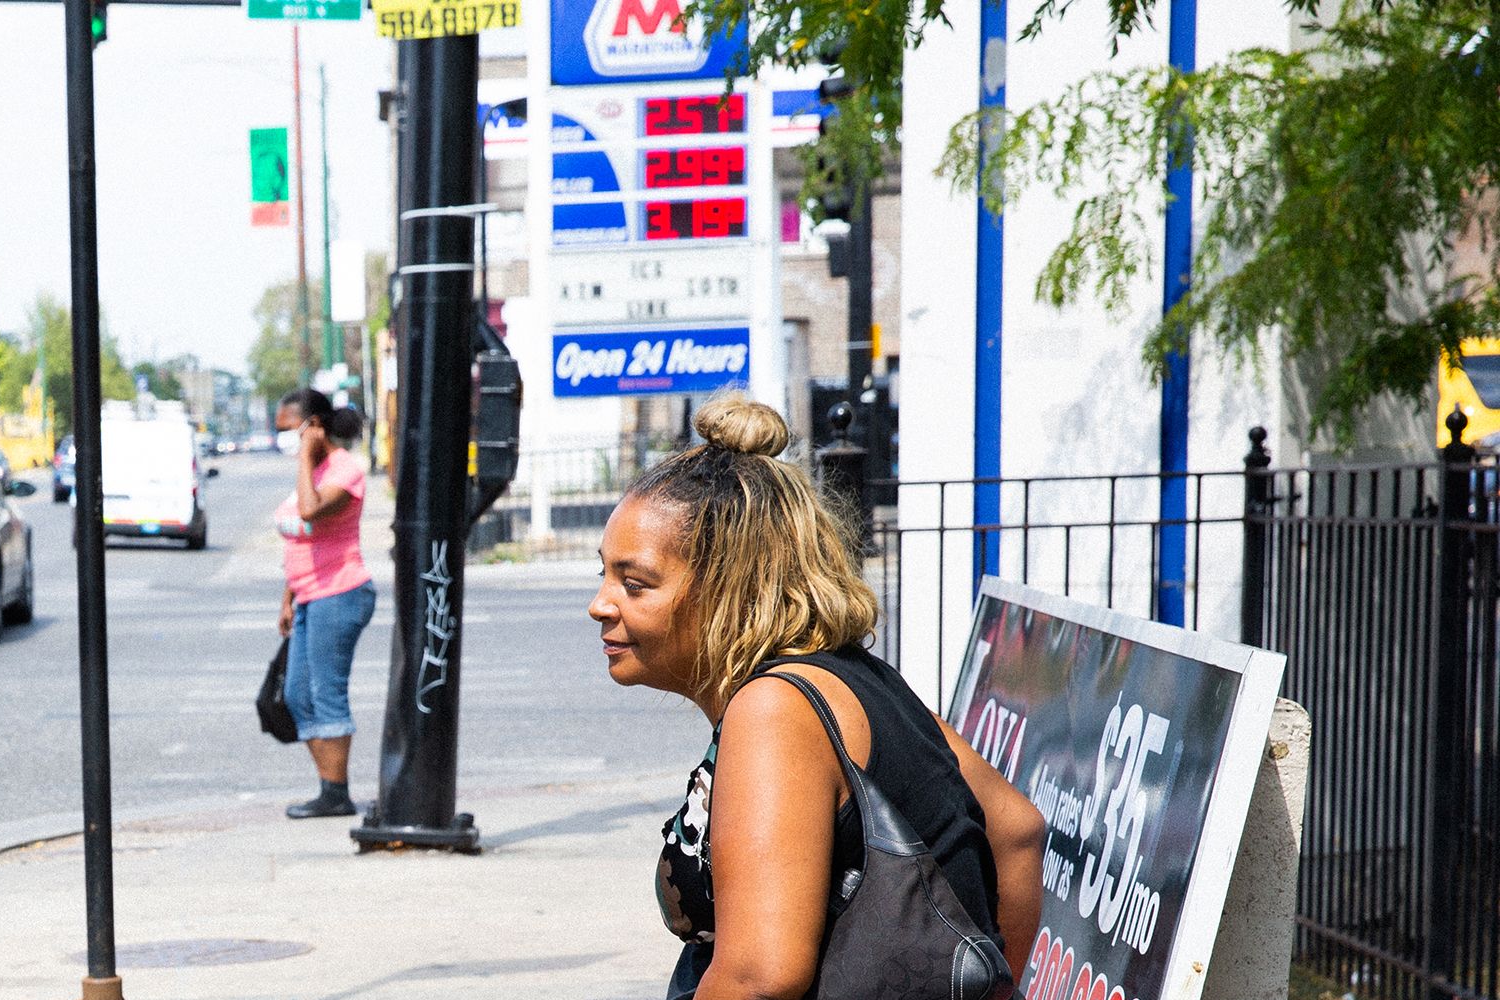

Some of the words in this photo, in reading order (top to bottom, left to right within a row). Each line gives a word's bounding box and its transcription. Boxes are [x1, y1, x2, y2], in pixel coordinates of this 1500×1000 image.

[612, 0, 686, 36] M
[556, 342, 627, 386] Open
[626, 340, 667, 376] 24
[666, 338, 748, 374] Hours
[1034, 763, 1059, 825] Auto
[1053, 786, 1082, 840] rates
[1043, 831, 1063, 893] low
[1057, 858, 1074, 902] as
